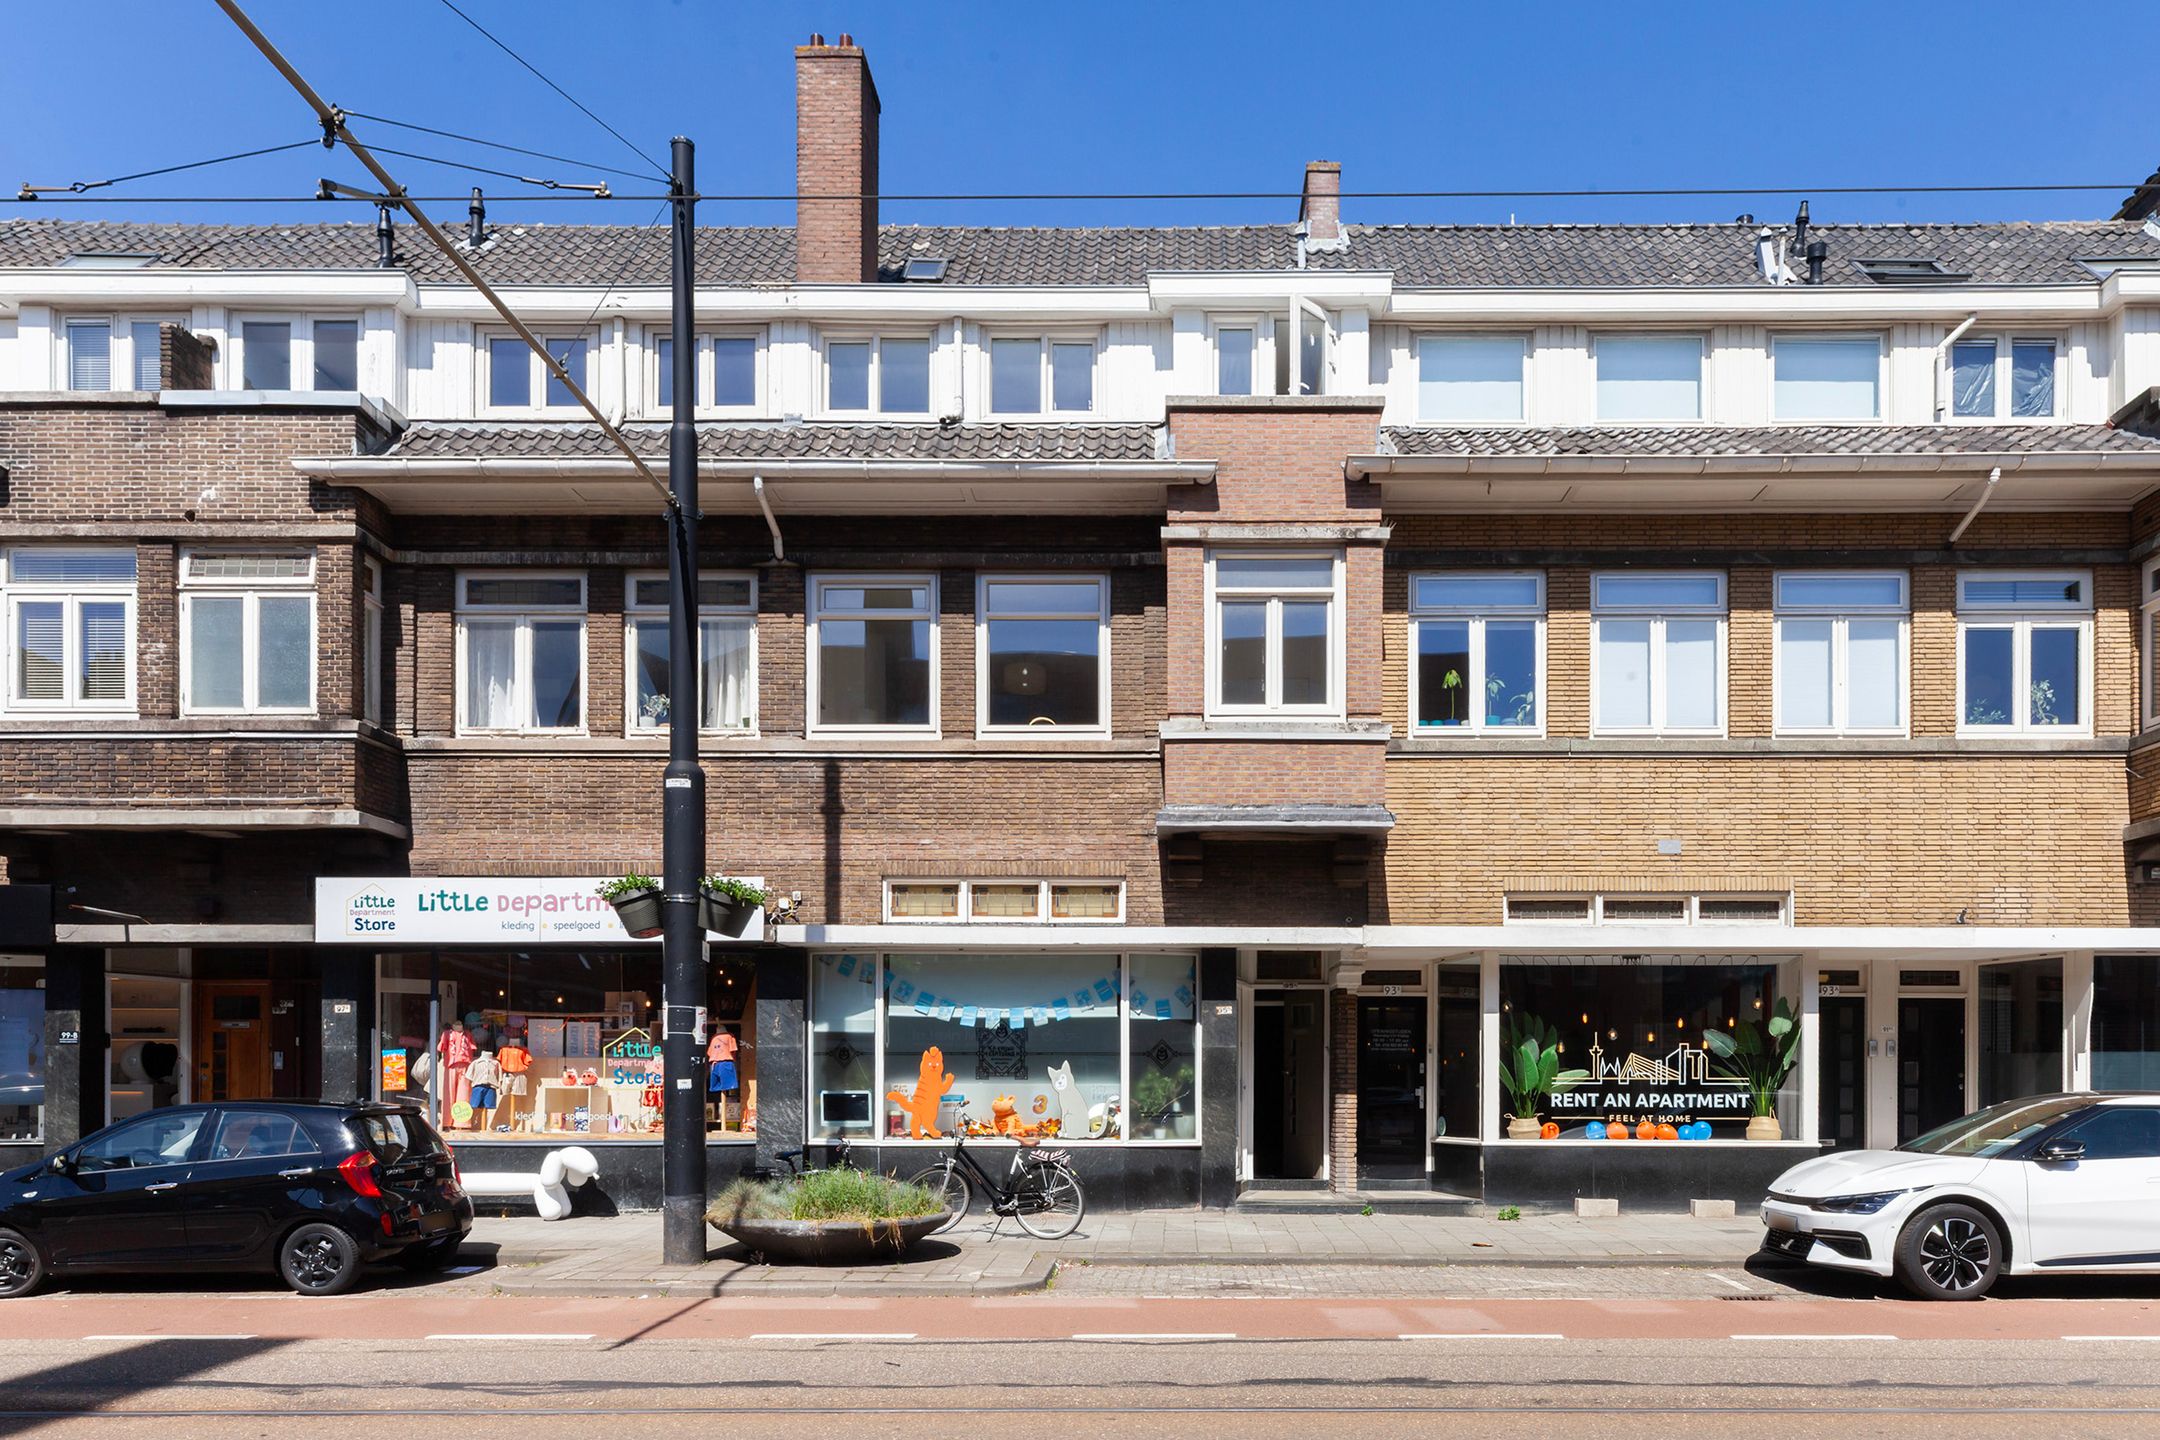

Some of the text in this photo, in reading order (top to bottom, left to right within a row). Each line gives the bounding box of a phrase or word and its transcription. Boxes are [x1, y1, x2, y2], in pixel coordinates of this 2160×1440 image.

[497, 893, 610, 917] Departm
[354, 917, 396, 931] Store
[501, 920, 601, 932] kleding speelgoed
[613, 1068, 662, 1084] Store
[1551, 1093, 1750, 1109] RENT AN APARTMENT
[1609, 1114, 1692, 1124] FEEL AT HOME
